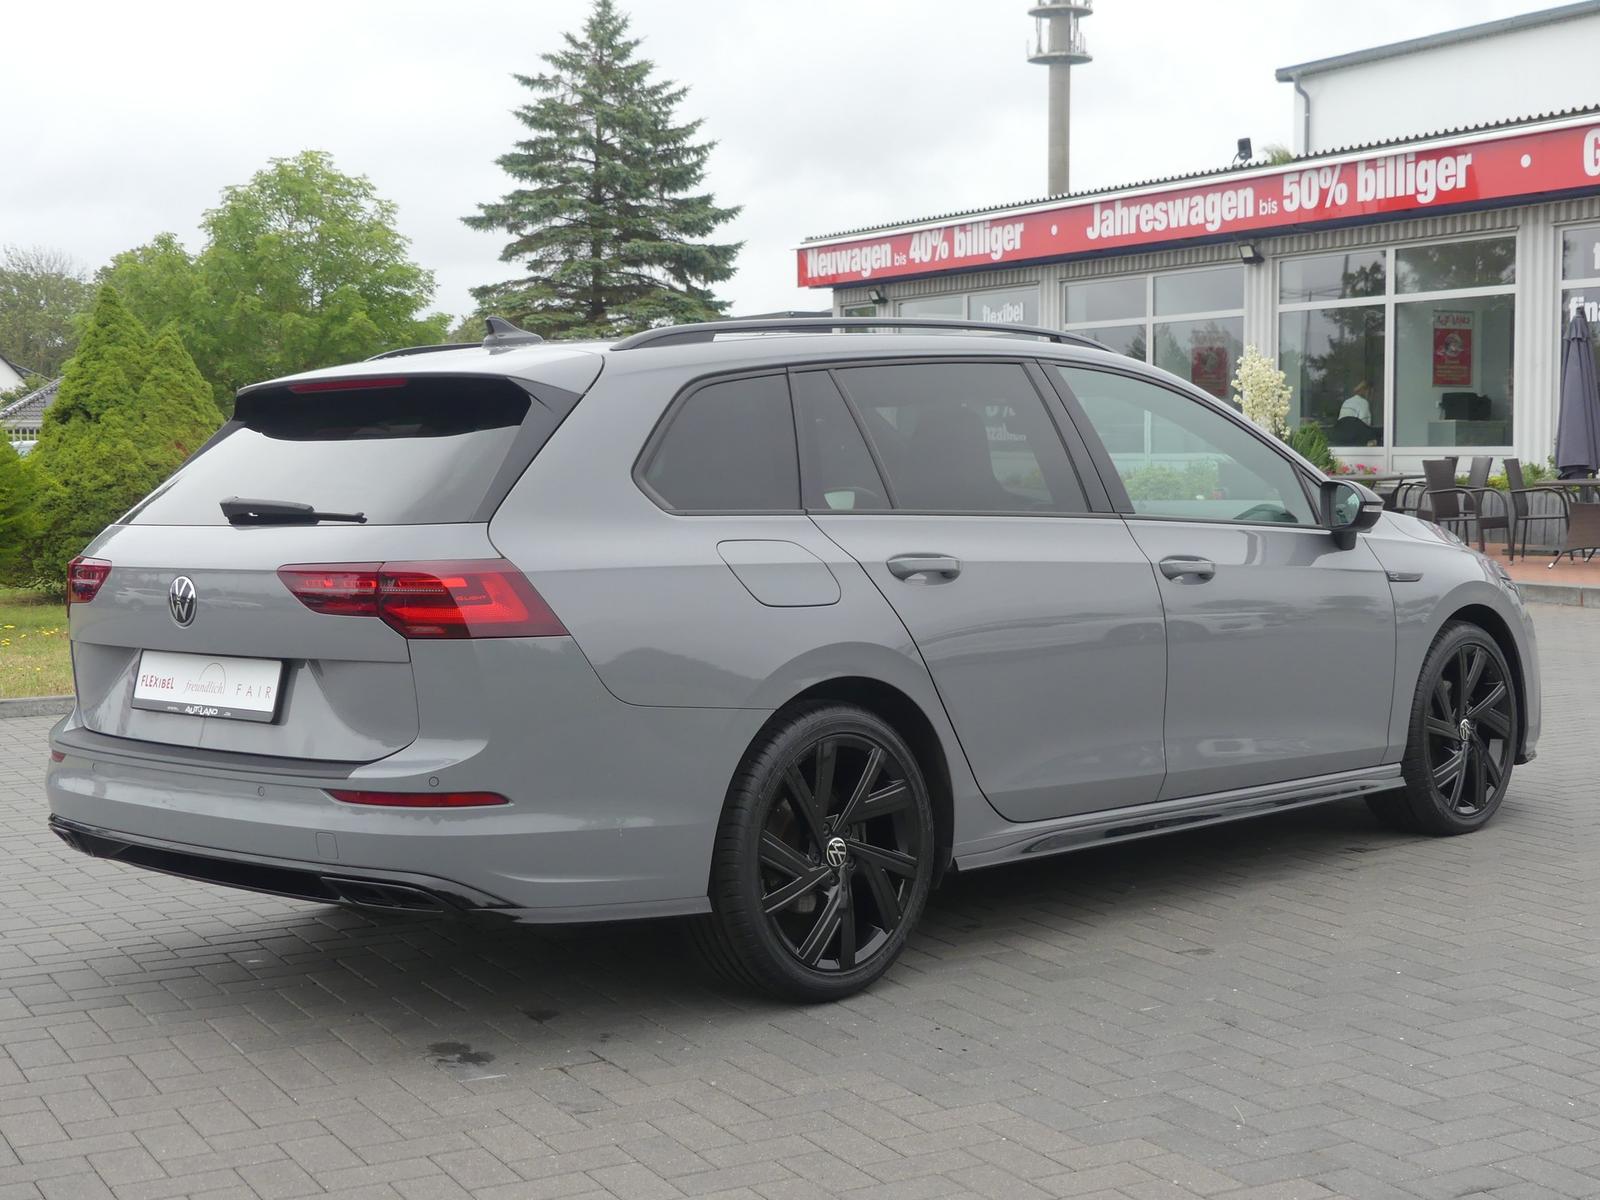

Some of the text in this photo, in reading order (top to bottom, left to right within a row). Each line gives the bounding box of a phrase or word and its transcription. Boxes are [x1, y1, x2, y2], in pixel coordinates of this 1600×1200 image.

[807, 243, 892, 278] Neuwagen
[894, 252, 907, 266] bis
[908, 228, 949, 264] 40%
[953, 220, 1024, 260] billiger
[1086, 187, 1254, 240] Jahreswagen
[1259, 198, 1278, 216] bis
[1282, 164, 1348, 212] 50%
[1356, 152, 1472, 204] billiger
[982, 301, 1024, 324] flexibel
[140, 674, 174, 690] FLEXIBEL
[184, 680, 225, 695] freundlich
